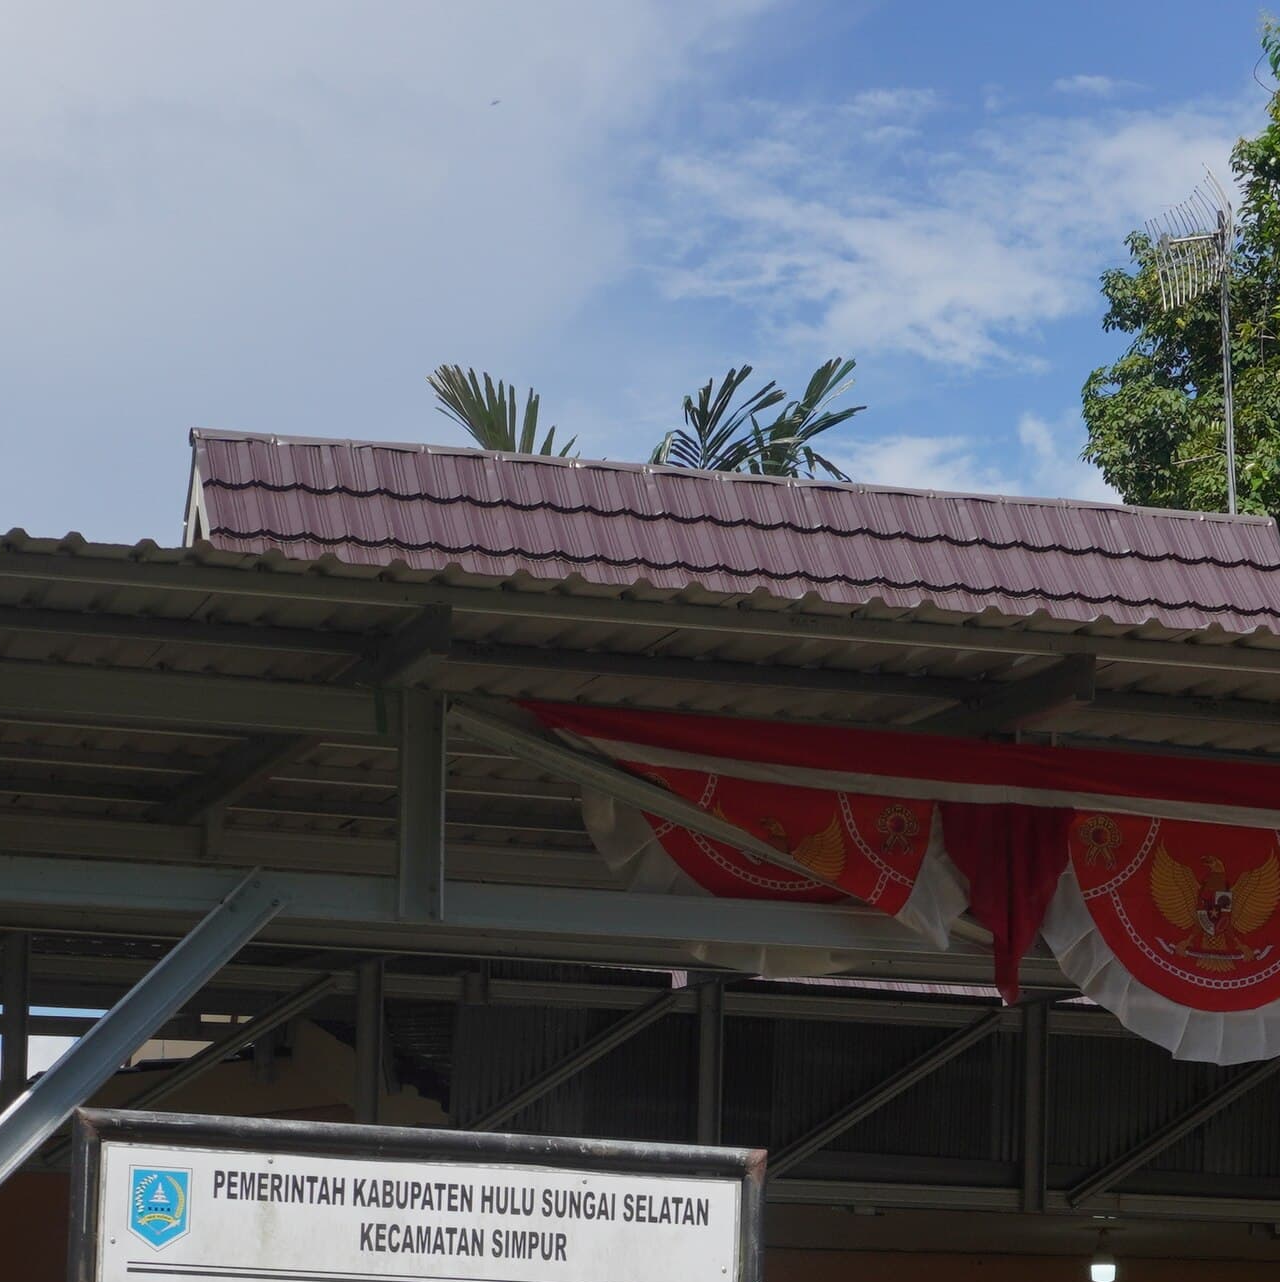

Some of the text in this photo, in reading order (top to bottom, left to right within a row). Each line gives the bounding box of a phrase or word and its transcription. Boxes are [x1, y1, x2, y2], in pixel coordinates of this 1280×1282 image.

[213, 1170, 709, 1226] PEMERINTAH KABUPATEN HULU SUNGAI SELATAN
[359, 1222, 567, 1262] KECAMATAN SIMPUR
